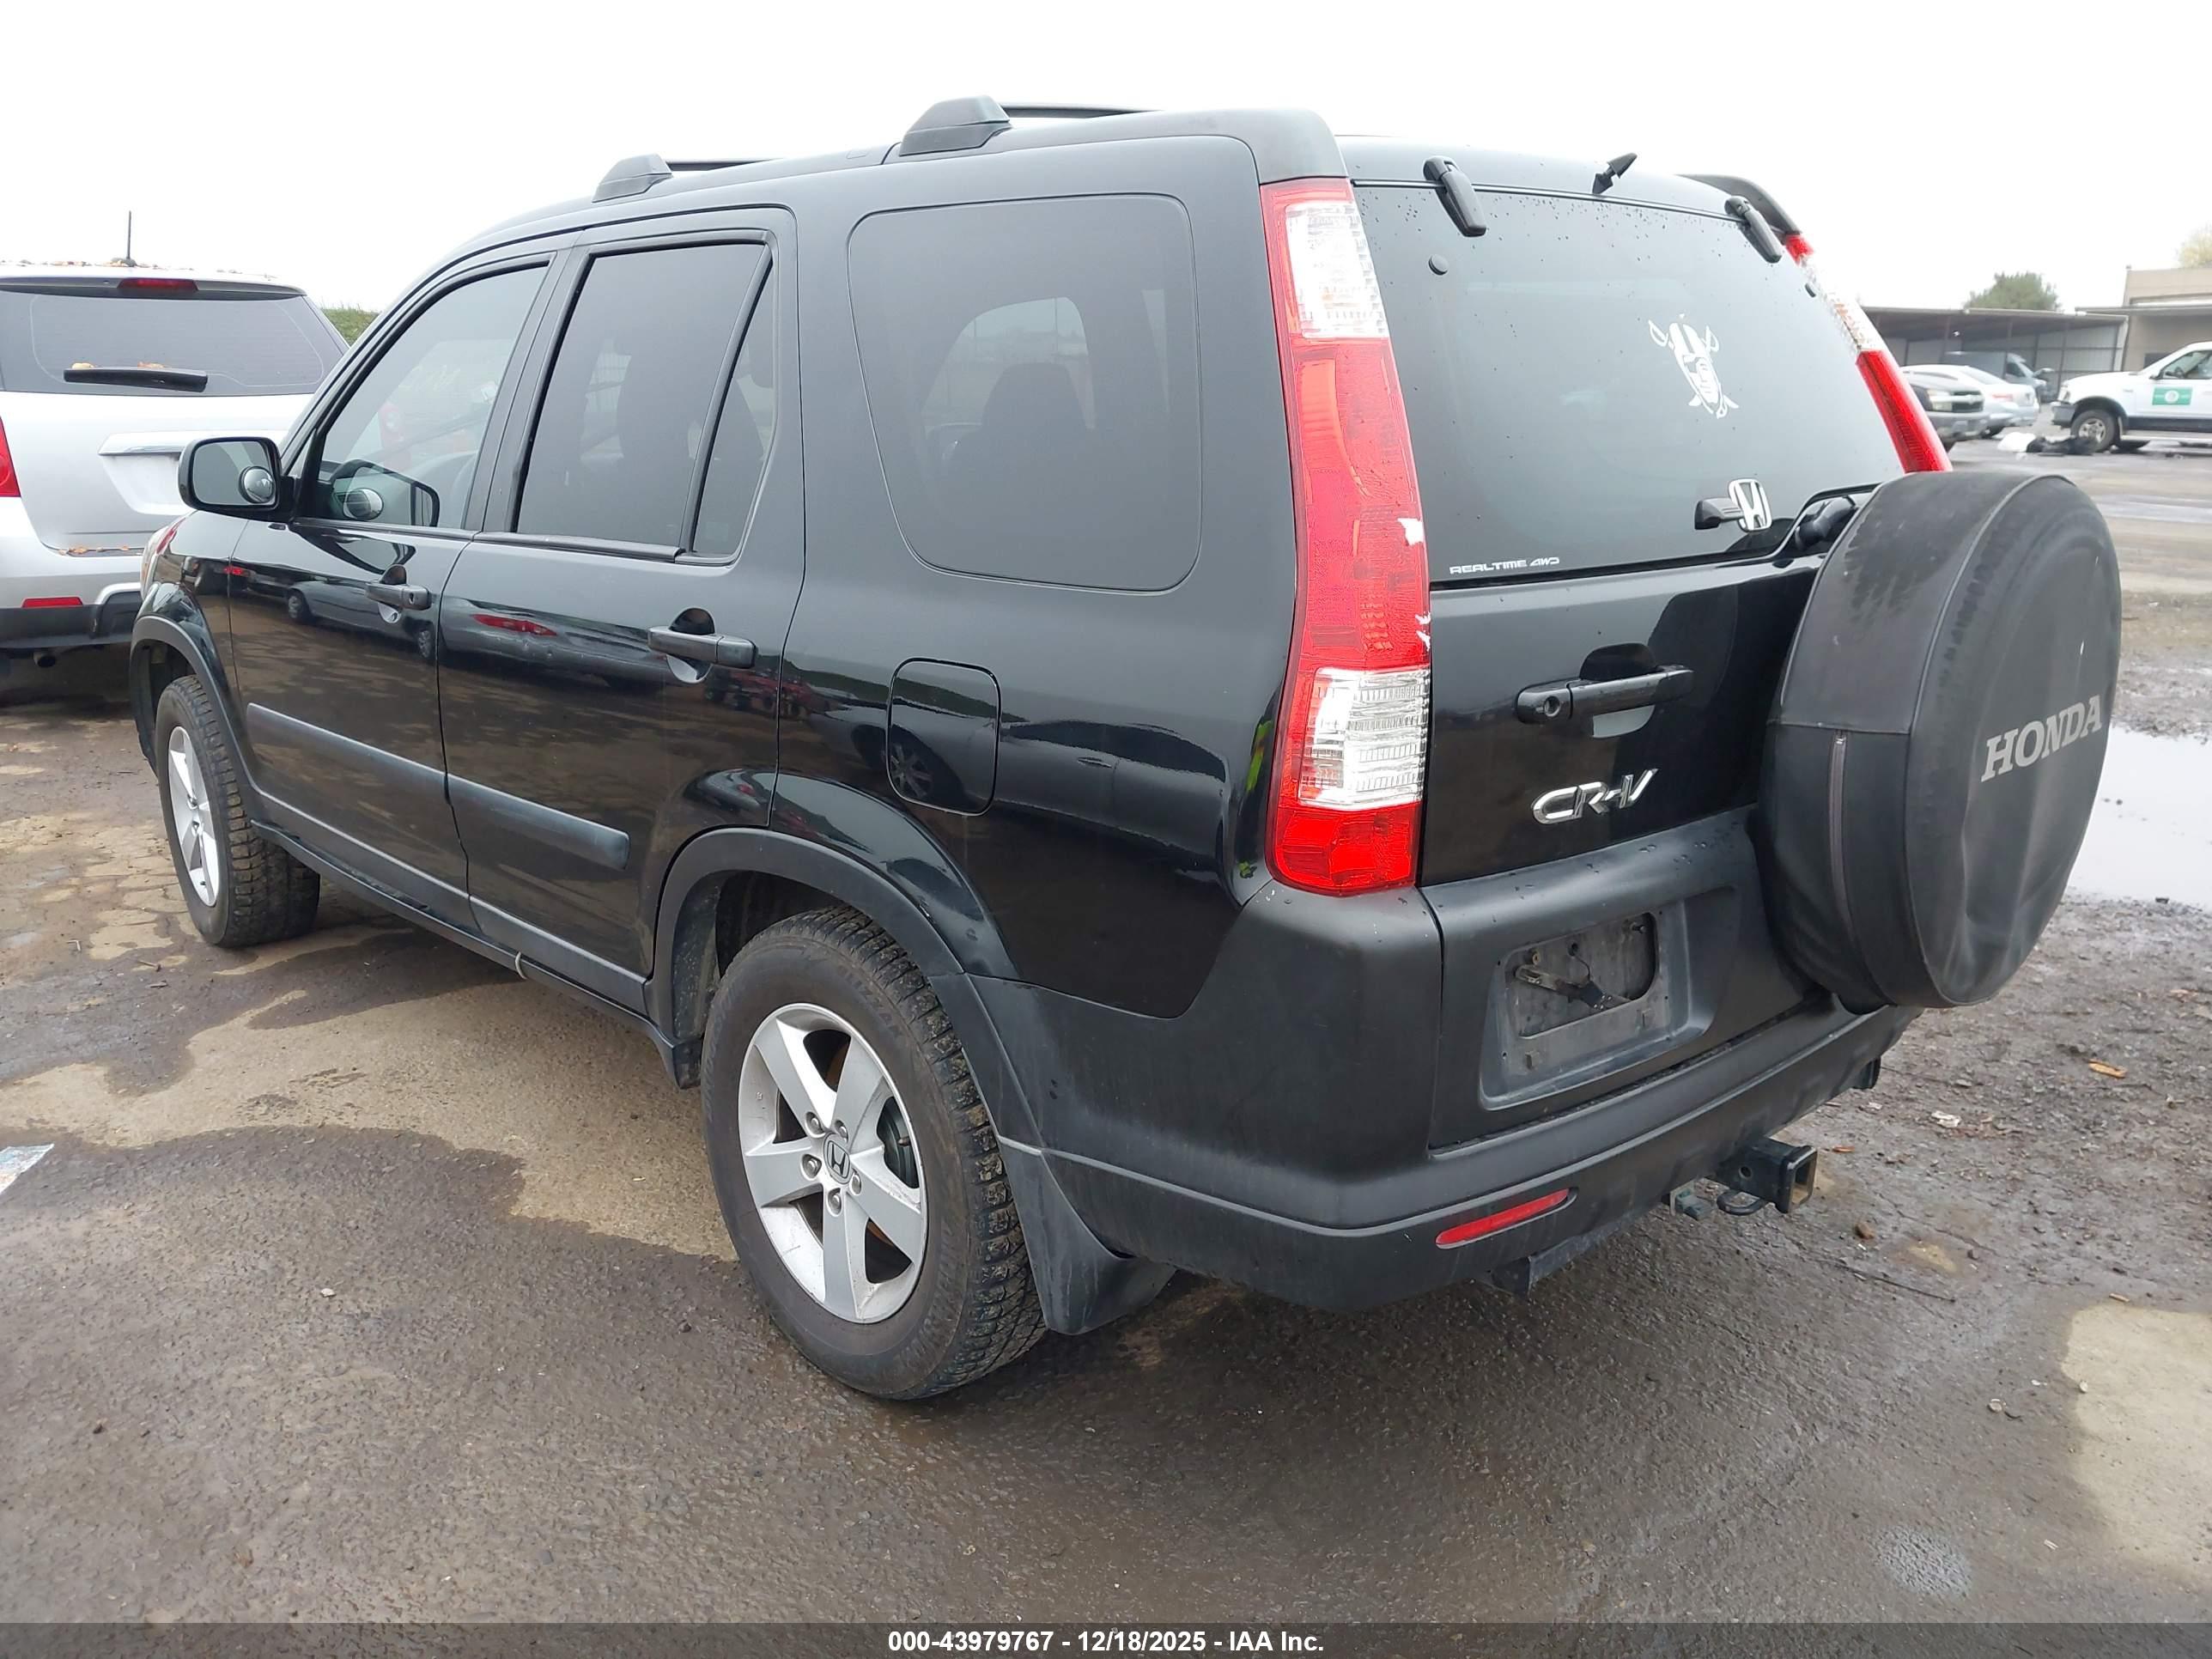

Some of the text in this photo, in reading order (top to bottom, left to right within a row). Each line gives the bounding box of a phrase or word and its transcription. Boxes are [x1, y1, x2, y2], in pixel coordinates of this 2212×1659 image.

[1449, 557, 1560, 574] REALTIME 4WD
[1981, 695, 2102, 782] HONDA
[1532, 769, 1658, 824] CR-V
